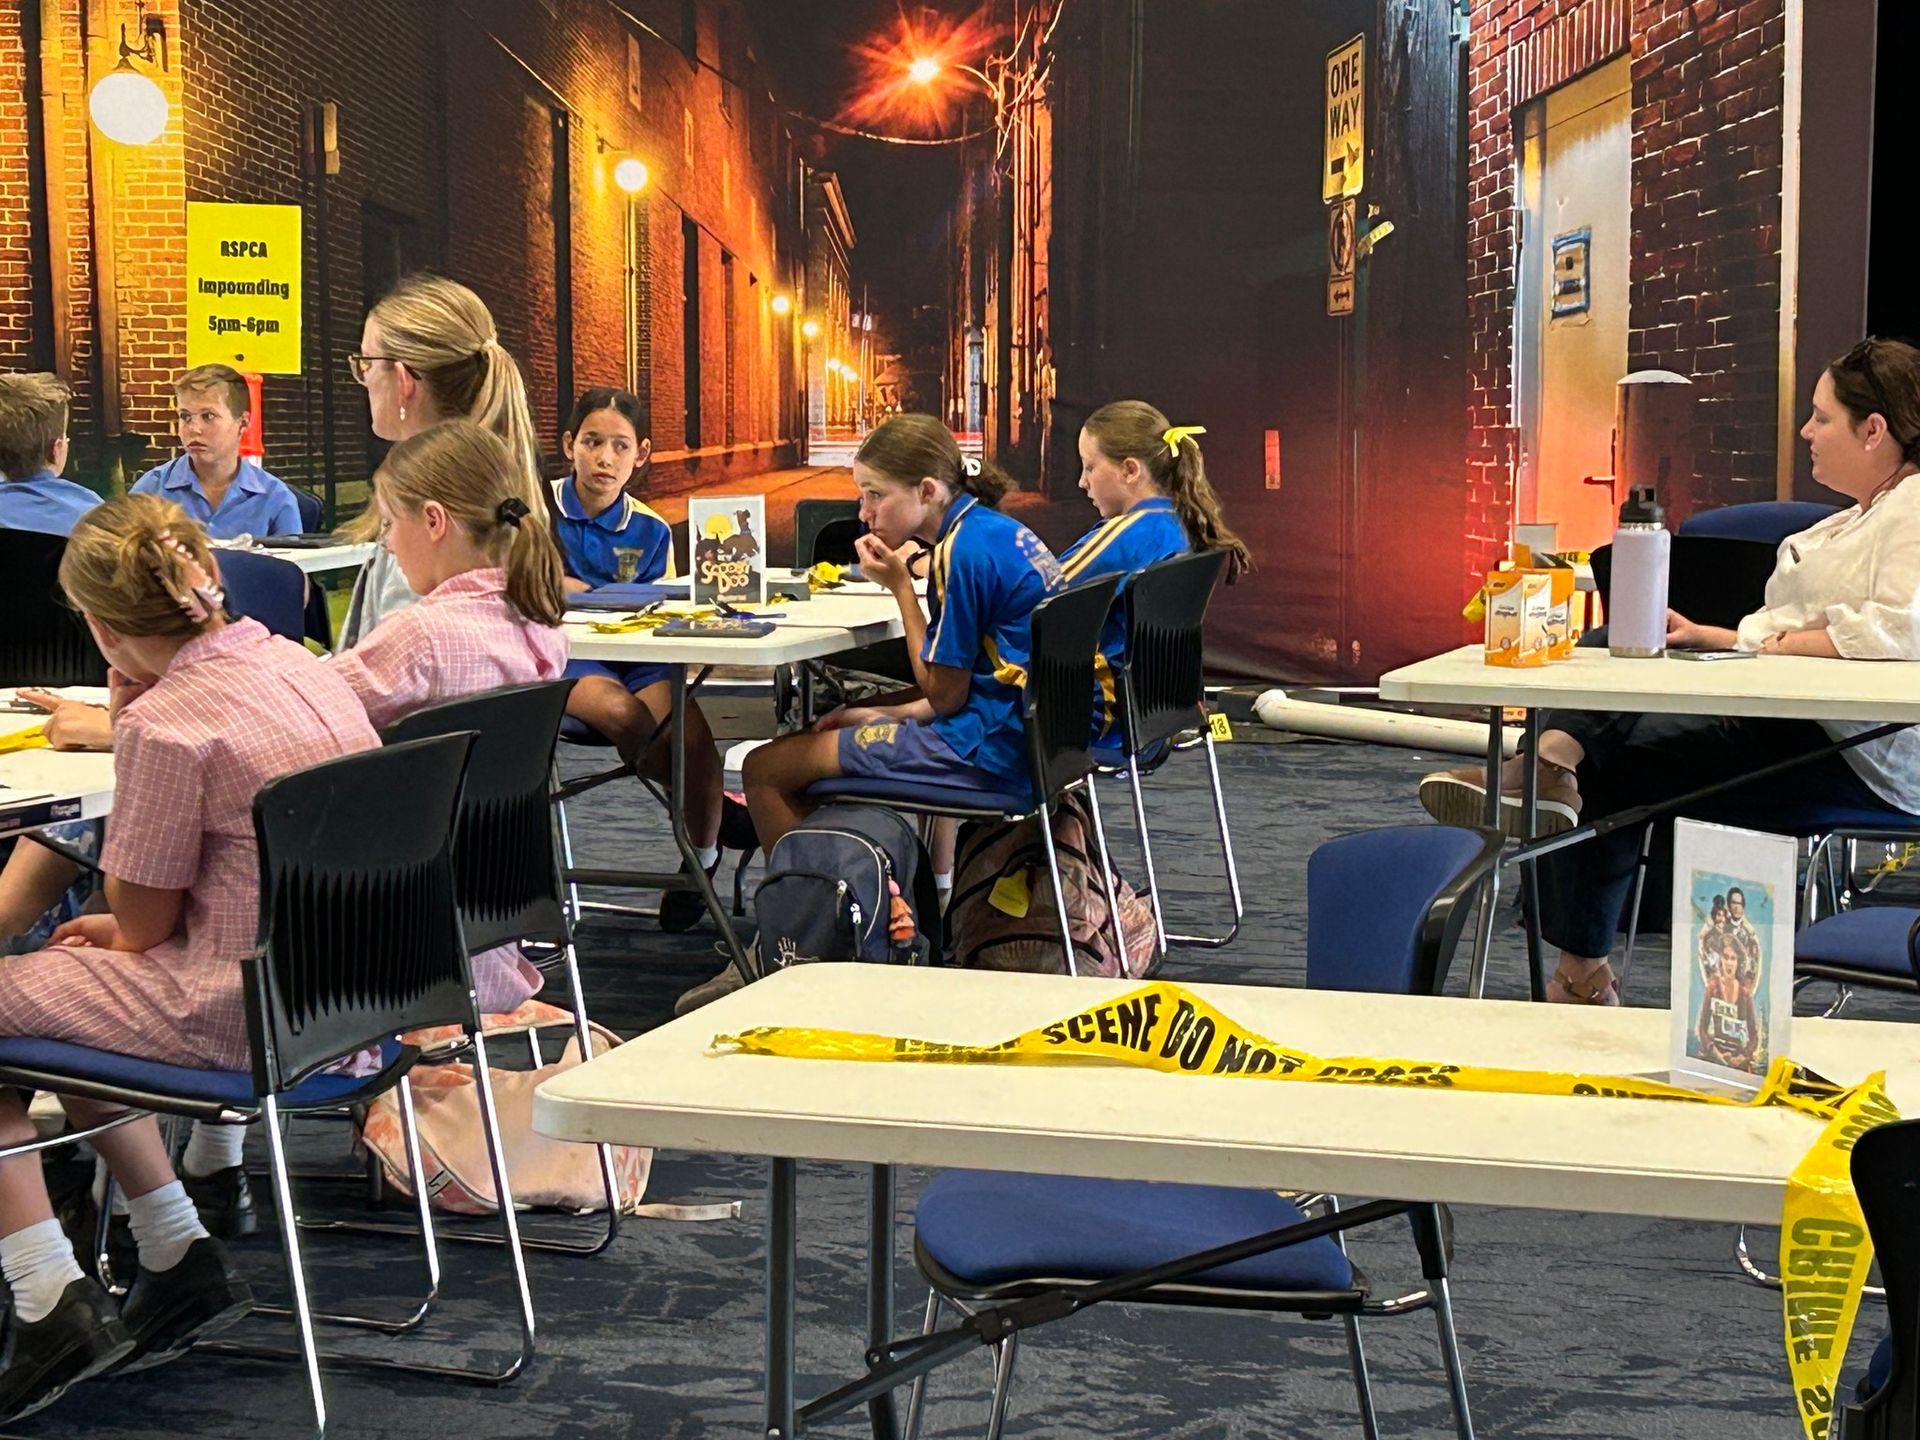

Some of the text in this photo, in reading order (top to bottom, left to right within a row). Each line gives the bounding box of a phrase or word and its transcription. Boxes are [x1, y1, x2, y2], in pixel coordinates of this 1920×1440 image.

[1330, 51, 1360, 98] ONE
[1329, 93, 1361, 140] WAY
[220, 240, 268, 258] RSPCA
[198, 277, 290, 299] Impounding
[208, 315, 280, 336] 5pm-6pm
[1041, 993, 1162, 1053] SCENE
[1159, 999, 1216, 1071] DO
[1212, 1034, 1306, 1074] NOT
